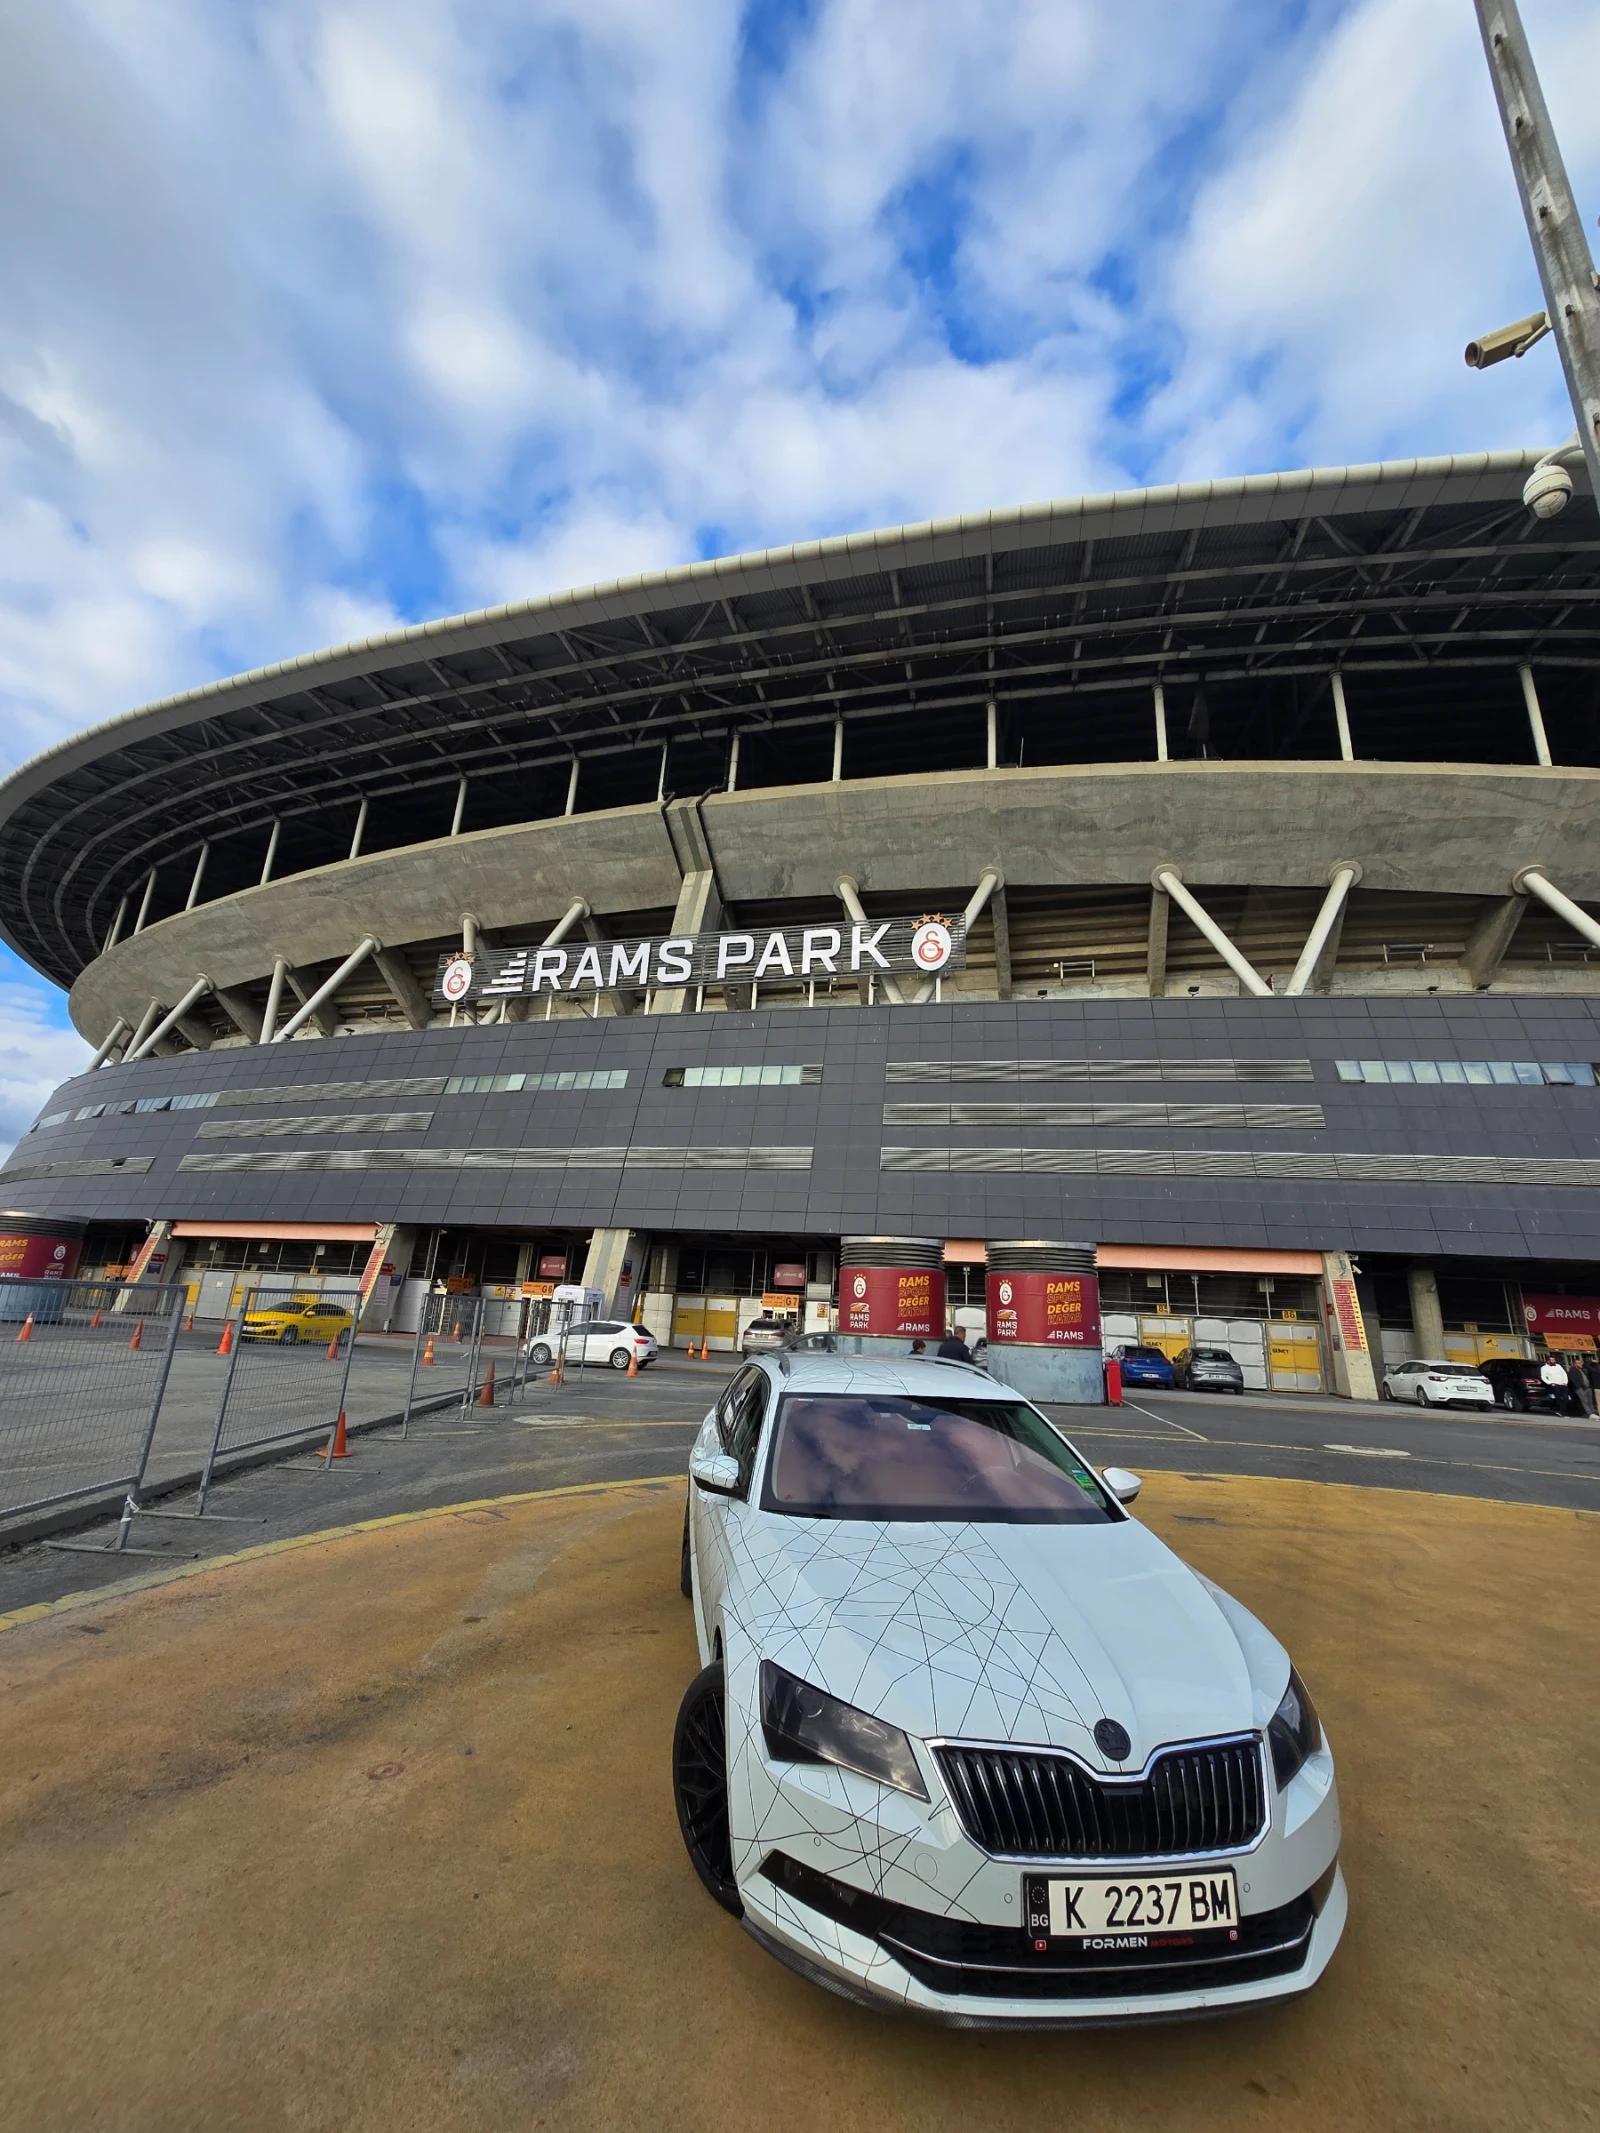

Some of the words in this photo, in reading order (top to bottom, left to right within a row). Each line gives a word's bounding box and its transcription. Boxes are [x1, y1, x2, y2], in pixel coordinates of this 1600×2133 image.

[532, 939, 694, 992] RAMS
[716, 923, 892, 979] PARK
[899, 1276, 930, 1288] RAMS
[1047, 1281, 1081, 1294] RAMS
[898, 1295, 930, 1307] DEĞER
[1047, 1301, 1082, 1315] DEĞER
[849, 1313, 870, 1321] RAMS
[1284, 1310, 1296, 1319] 86
[1555, 1309, 1591, 1320] RAMS
[850, 1320, 869, 1329] PARK
[905, 1322, 930, 1332] RAMS
[996, 1320, 1018, 1329] RAMS
[997, 1328, 1017, 1337] PARK
[1056, 1330, 1084, 1340] RAMS
[1064, 1886, 1087, 1929] K
[1104, 1882, 1183, 1928] 2237
[1189, 1879, 1232, 1923] BM
[1031, 1914, 1049, 1927] BG
[1083, 1936, 1148, 1950] FORMEN
[1150, 1936, 1195, 1948] MOTORS
